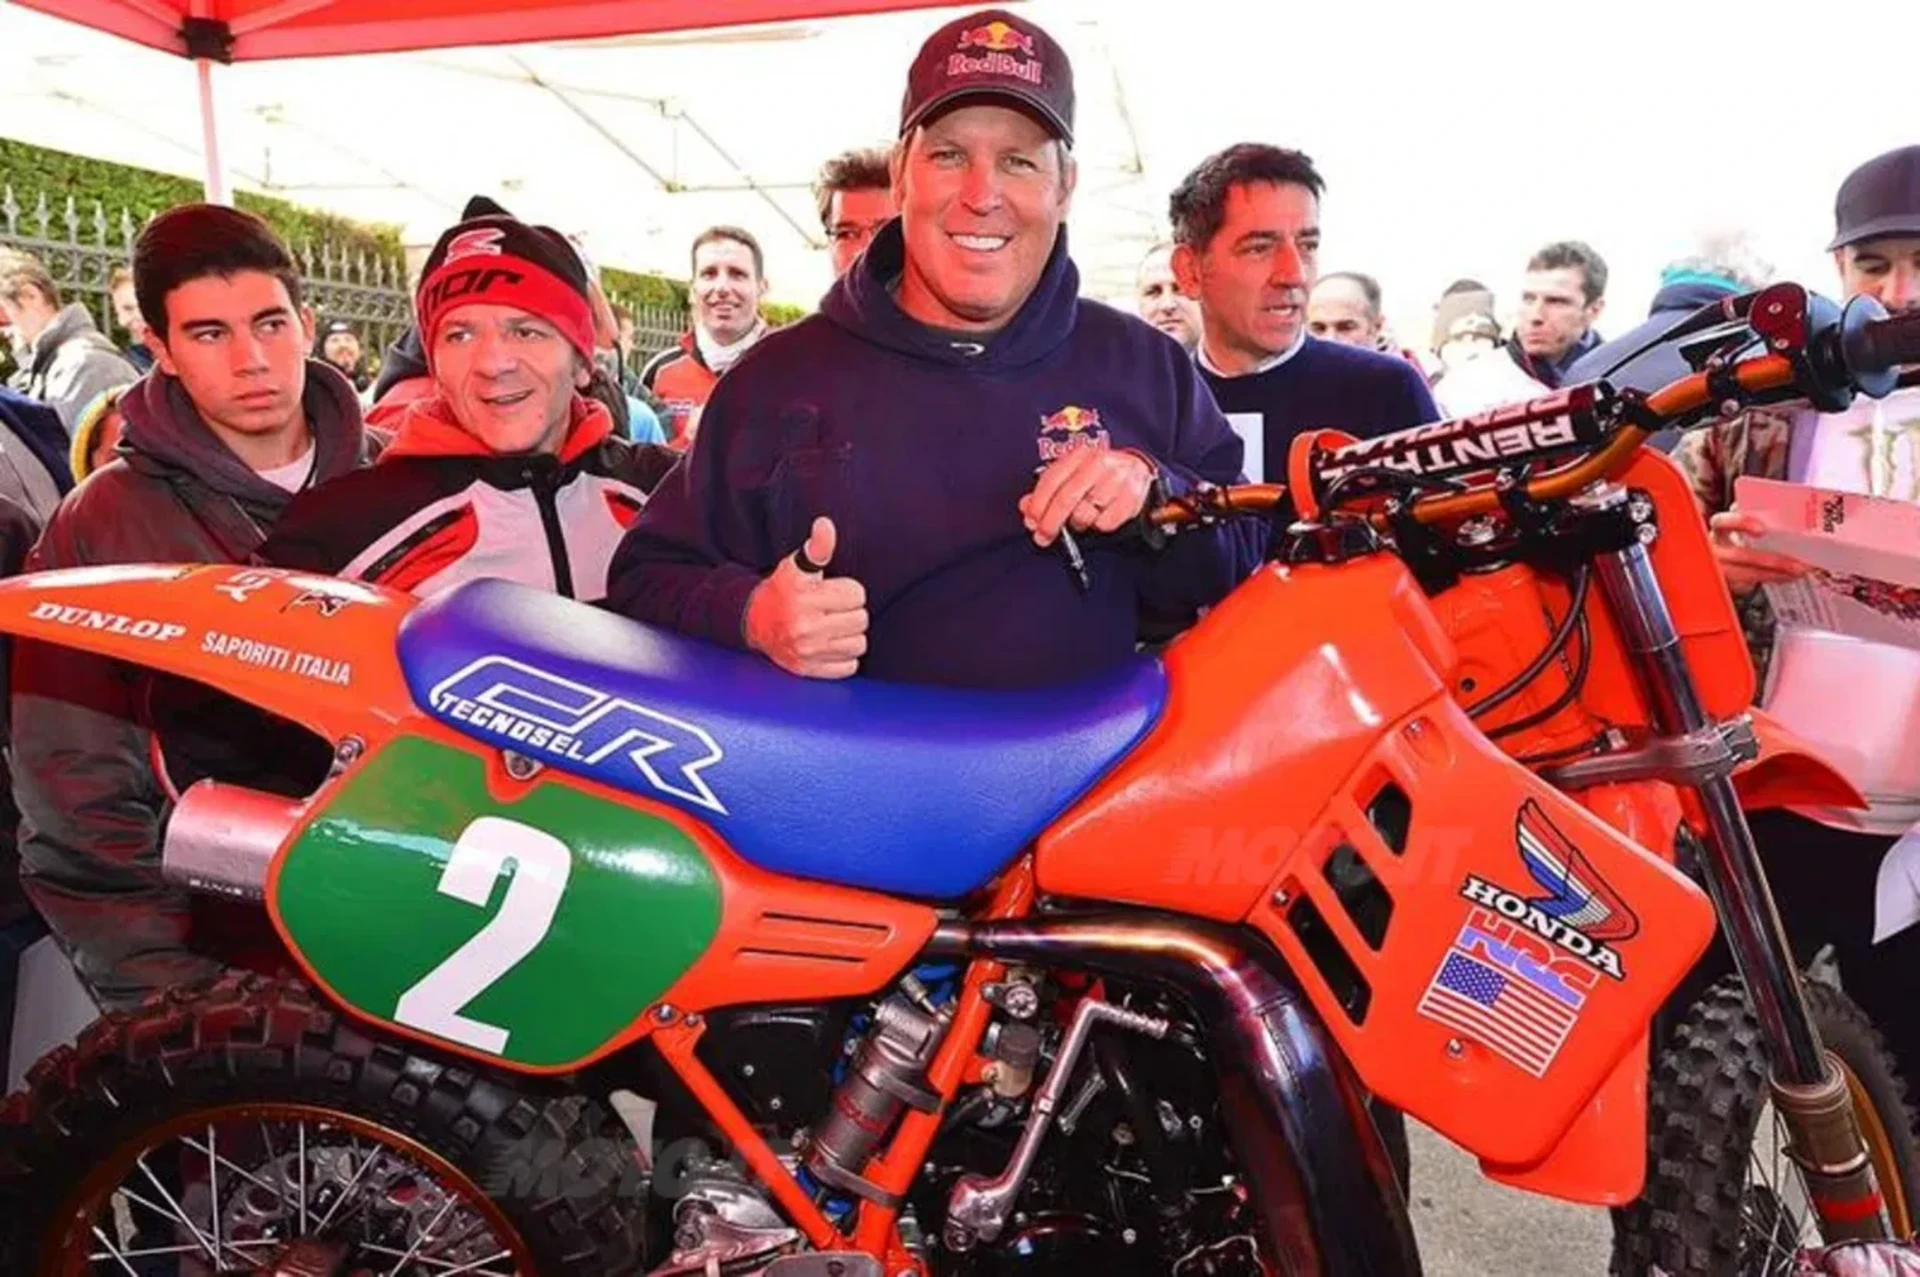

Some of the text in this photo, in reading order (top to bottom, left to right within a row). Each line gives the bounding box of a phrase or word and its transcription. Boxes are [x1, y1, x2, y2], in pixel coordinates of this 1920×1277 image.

[1320, 413, 1577, 480] RENTHL
[28, 601, 188, 641] DUNLOP
[201, 630, 351, 686] SAPORITI ITALIA
[436, 692, 586, 762] TECNOSEL
[394, 816, 572, 1055] 2
[1455, 906, 1602, 1012] HRC
[1459, 874, 1626, 981] HONDA
